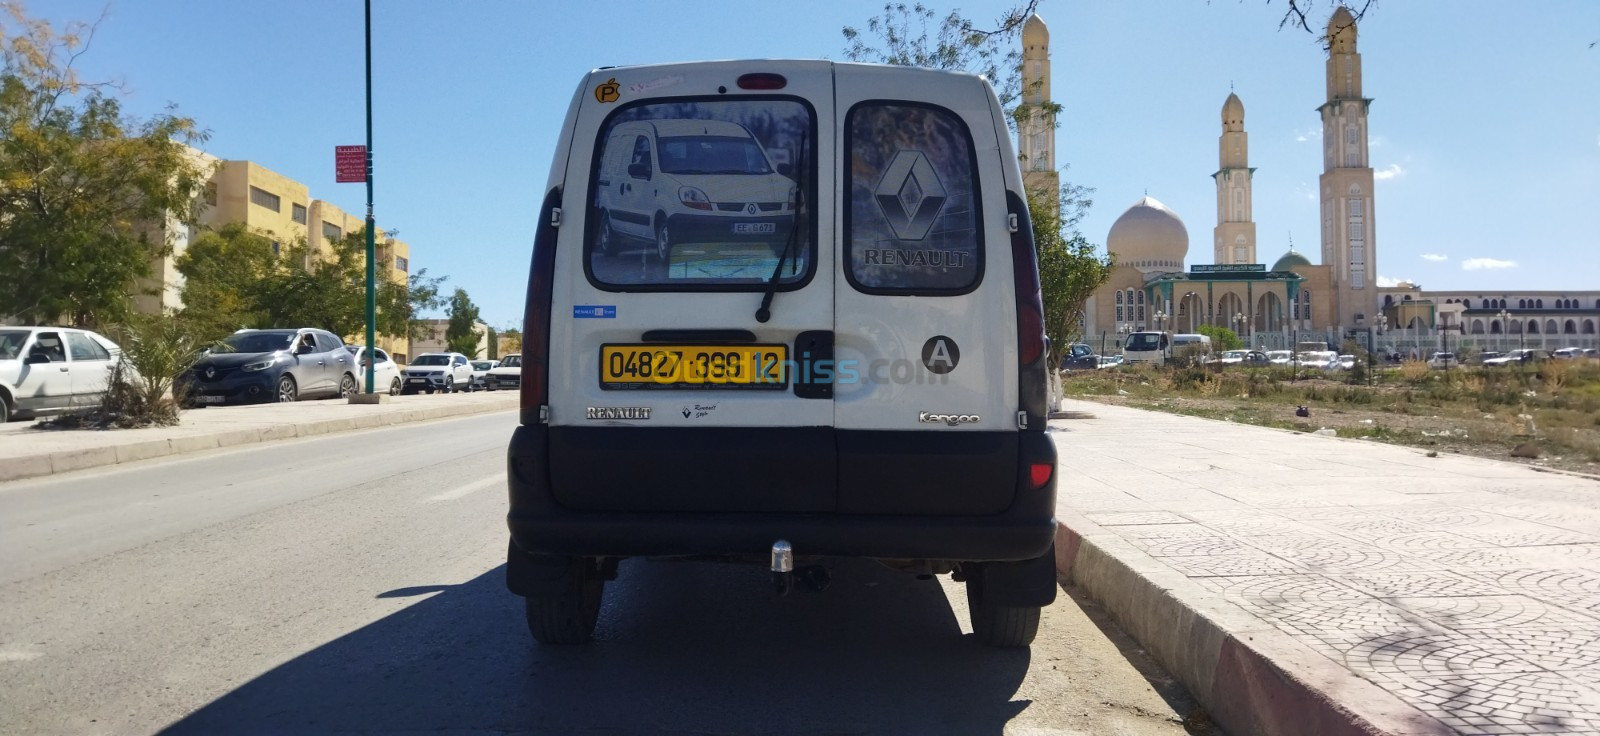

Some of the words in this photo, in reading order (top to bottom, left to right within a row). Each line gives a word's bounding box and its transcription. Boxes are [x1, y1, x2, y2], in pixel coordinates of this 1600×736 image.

[863, 249, 969, 268] RENAULT
[927, 339, 954, 368] A
[610, 351, 683, 378] 04827
[586, 407, 652, 420] RENAULT
[918, 410, 981, 426] Kangoo
